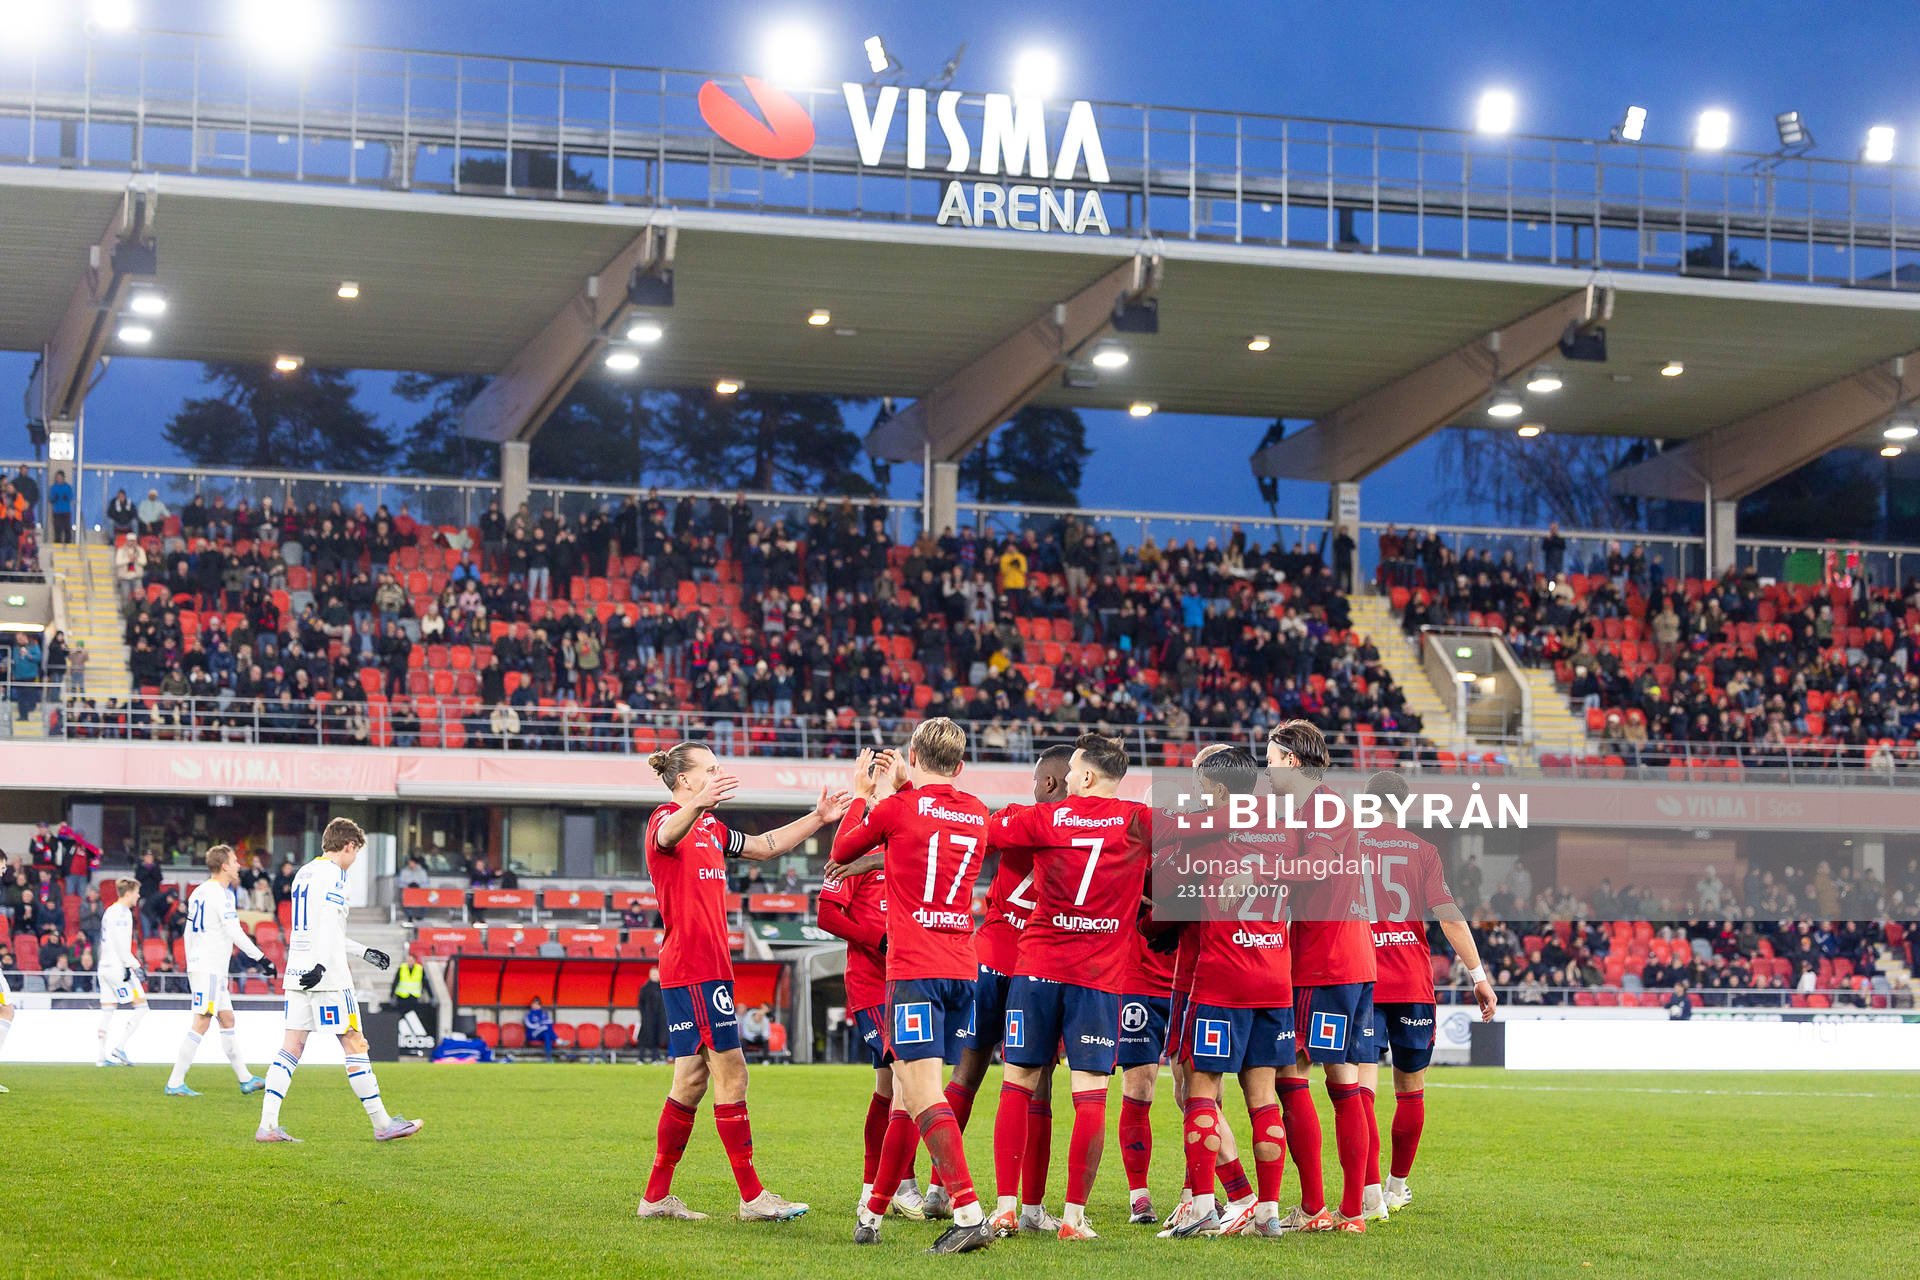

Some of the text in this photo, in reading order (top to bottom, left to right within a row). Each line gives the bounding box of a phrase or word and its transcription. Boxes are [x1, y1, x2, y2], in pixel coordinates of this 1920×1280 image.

[842, 82, 1110, 182] VISMA
[936, 180, 1110, 236] ARENA
[208, 757, 282, 783] VISMA
[924, 804, 984, 826] Fellessons
[1058, 814, 1125, 828] Fellessons
[1358, 835, 1420, 850] Fellessons
[923, 830, 978, 905] 17
[1071, 838, 1104, 906] 7
[1360, 852, 1411, 924] 15
[192, 899, 206, 933] 21
[292, 883, 310, 931] 11
[1052, 913, 1120, 930] dynacon
[1232, 929, 1283, 948] dynacon
[1400, 1016, 1433, 1026] SHARP
[1080, 1034, 1115, 1048] SHARP
[1119, 1036, 1143, 1044] olmgrens
[1276, 1030, 1296, 1041] SHA
